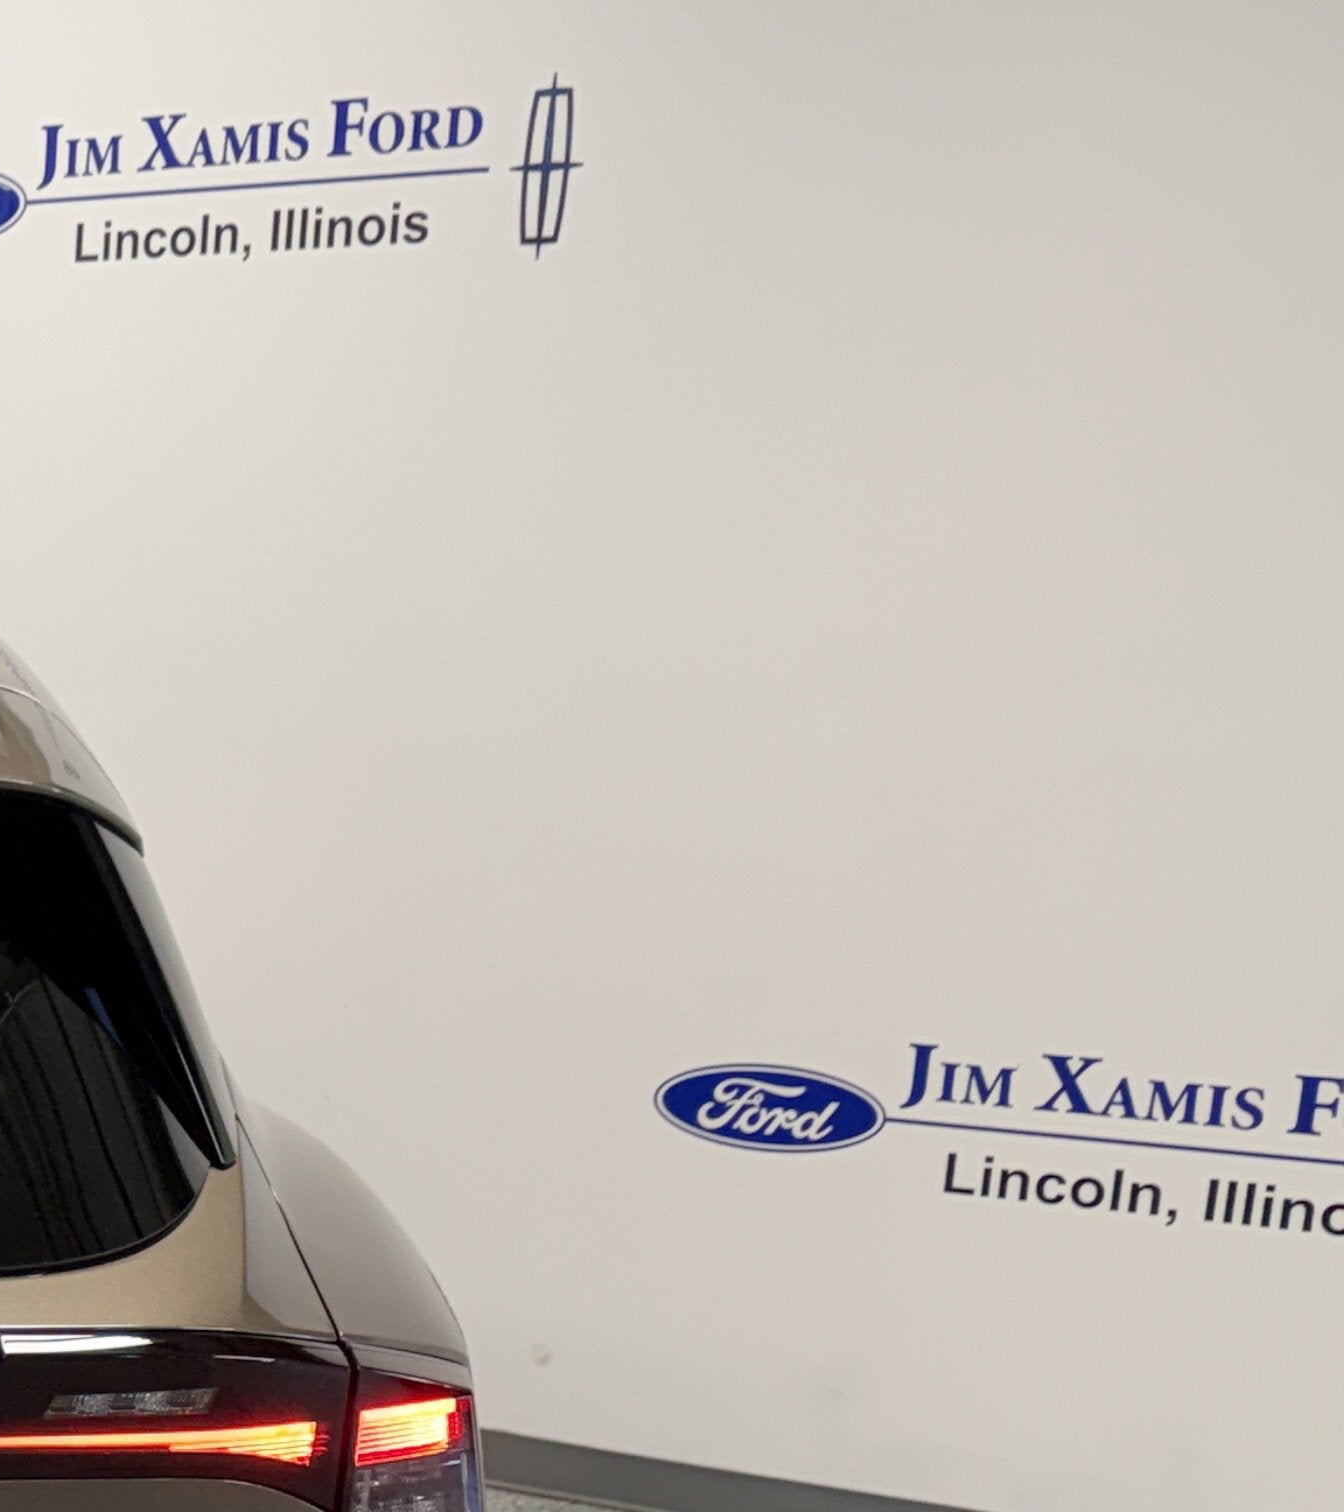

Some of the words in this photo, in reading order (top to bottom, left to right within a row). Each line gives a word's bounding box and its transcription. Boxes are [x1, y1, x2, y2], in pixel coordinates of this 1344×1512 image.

[36, 124, 123, 191] JIM
[137, 113, 310, 173] XAMIS
[326, 96, 484, 158] FORD
[74, 213, 252, 263] Lincoln,
[269, 201, 429, 252] Illinois
[696, 1076, 840, 1142] Ford
[898, 1042, 1019, 1110] JIM
[1032, 1053, 1266, 1132] XAMIS
[942, 1151, 1178, 1227] Lincoln,
